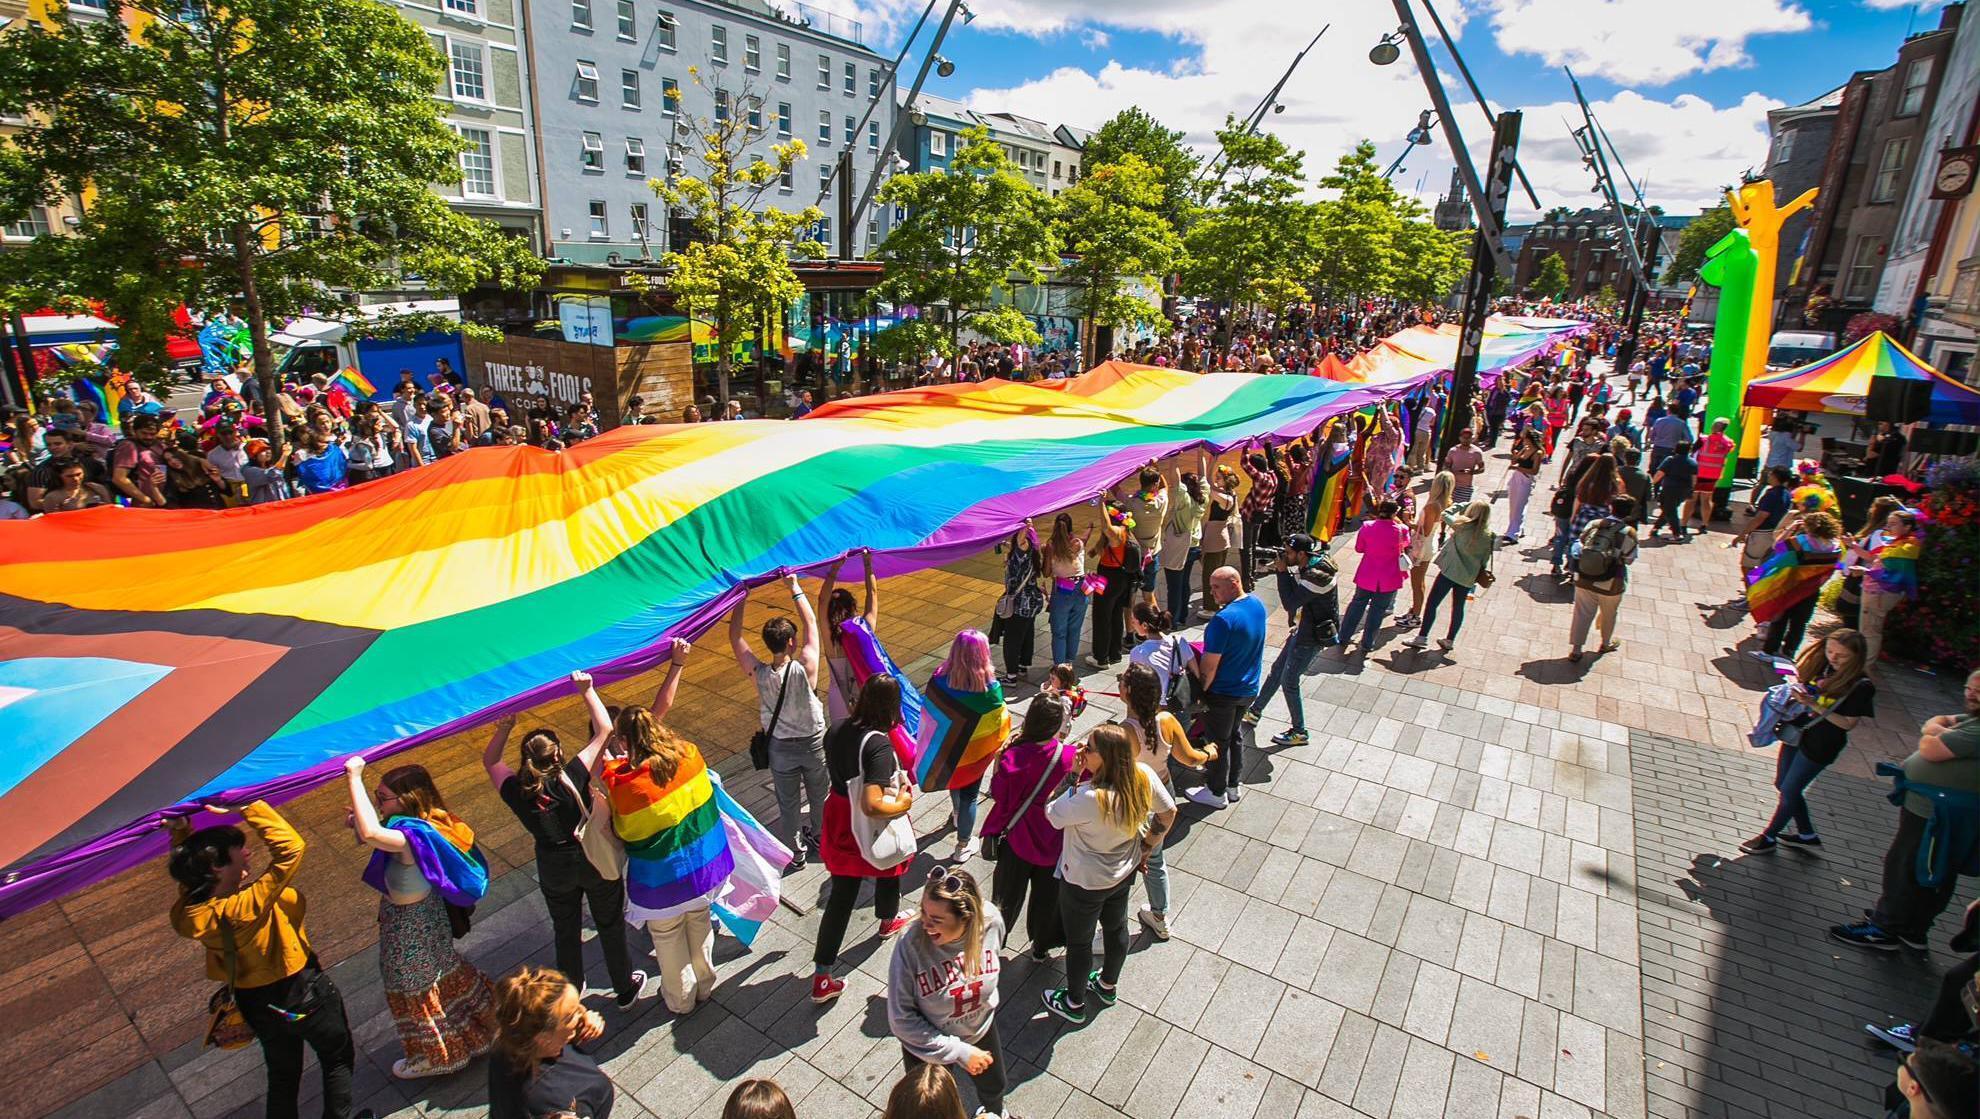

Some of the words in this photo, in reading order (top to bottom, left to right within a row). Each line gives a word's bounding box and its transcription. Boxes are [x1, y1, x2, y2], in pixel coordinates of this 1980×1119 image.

[812, 223, 820, 237] P
[485, 361, 524, 393] THREE
[516, 397, 563, 416] COFE
[949, 980, 983, 1018] H
